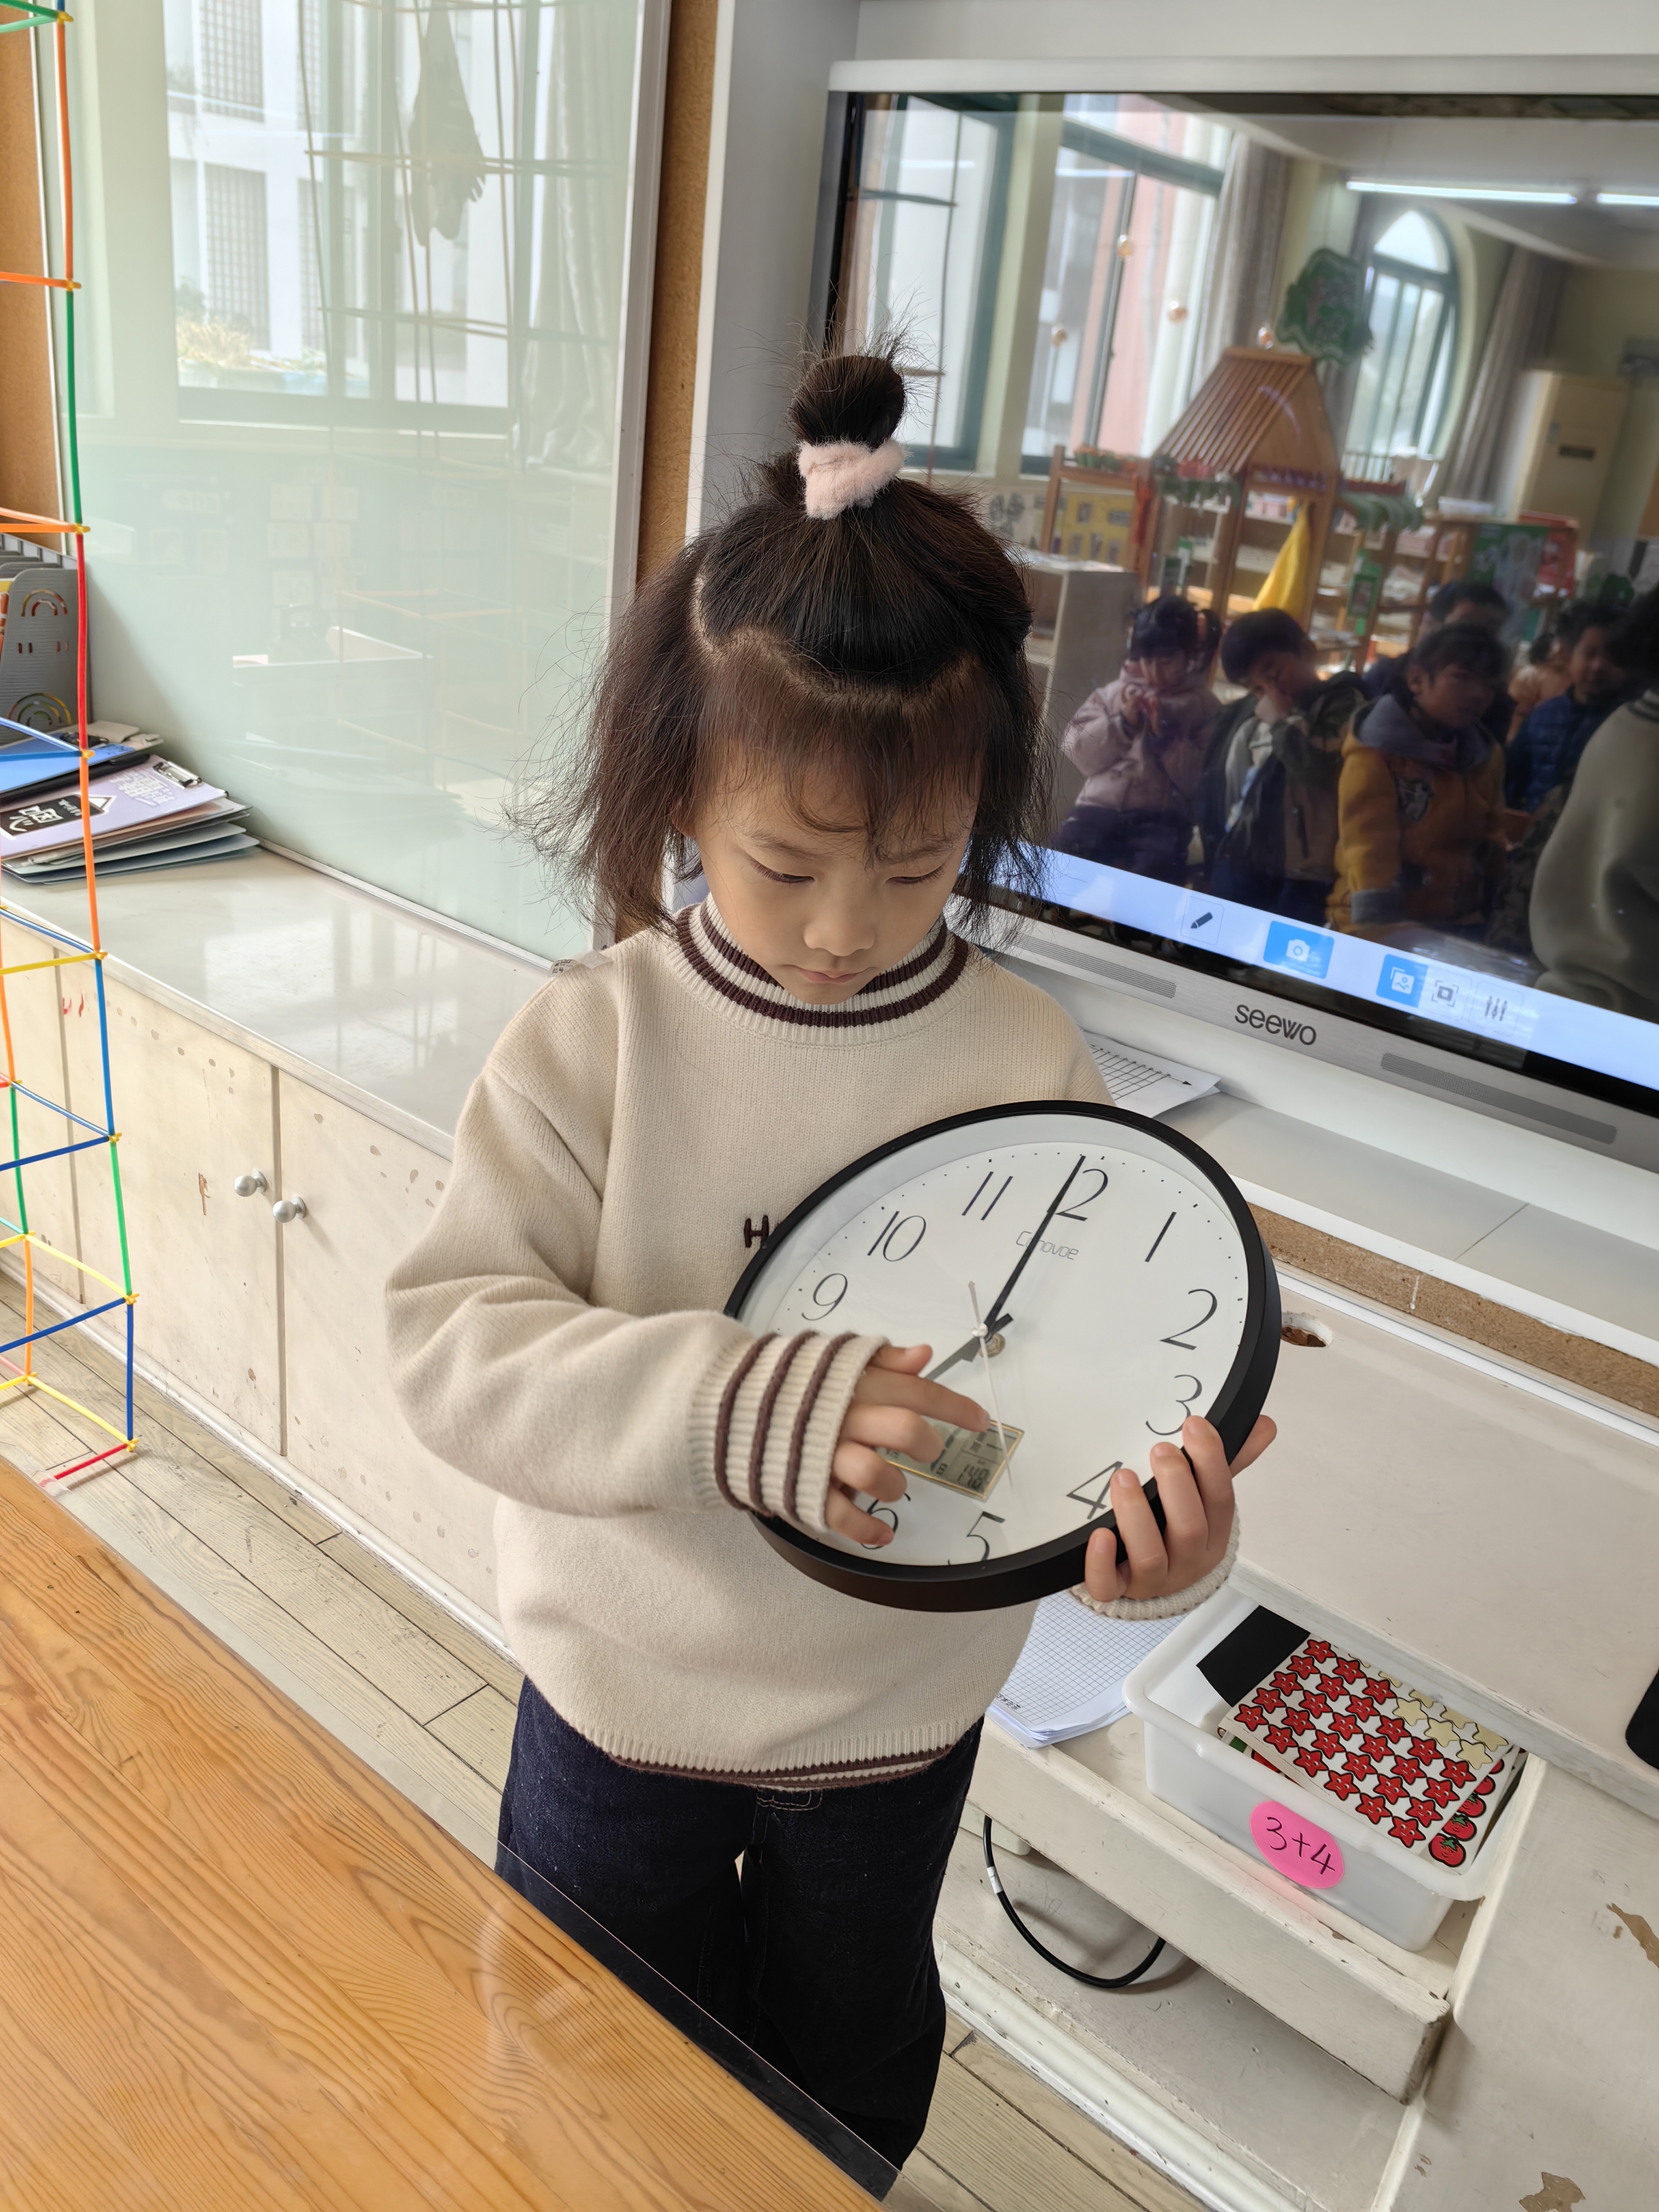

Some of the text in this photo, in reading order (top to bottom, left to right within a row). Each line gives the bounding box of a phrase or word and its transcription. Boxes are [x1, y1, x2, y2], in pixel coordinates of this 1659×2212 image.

[1235, 1004, 1317, 1046] seewo
[961, 1171, 1013, 1221] 11
[1047, 1165, 1109, 1222] 2
[867, 1210, 927, 1262] 10
[1144, 1211, 1177, 1263] 1
[801, 1273, 848, 1321] 9
[1158, 1289, 1218, 1351] 2
[1145, 1374, 1203, 1435] 3
[1065, 1460, 1123, 1520] 4
[948, 1511, 1006, 1566] 5
[1266, 1816, 1336, 1875] 3+4
